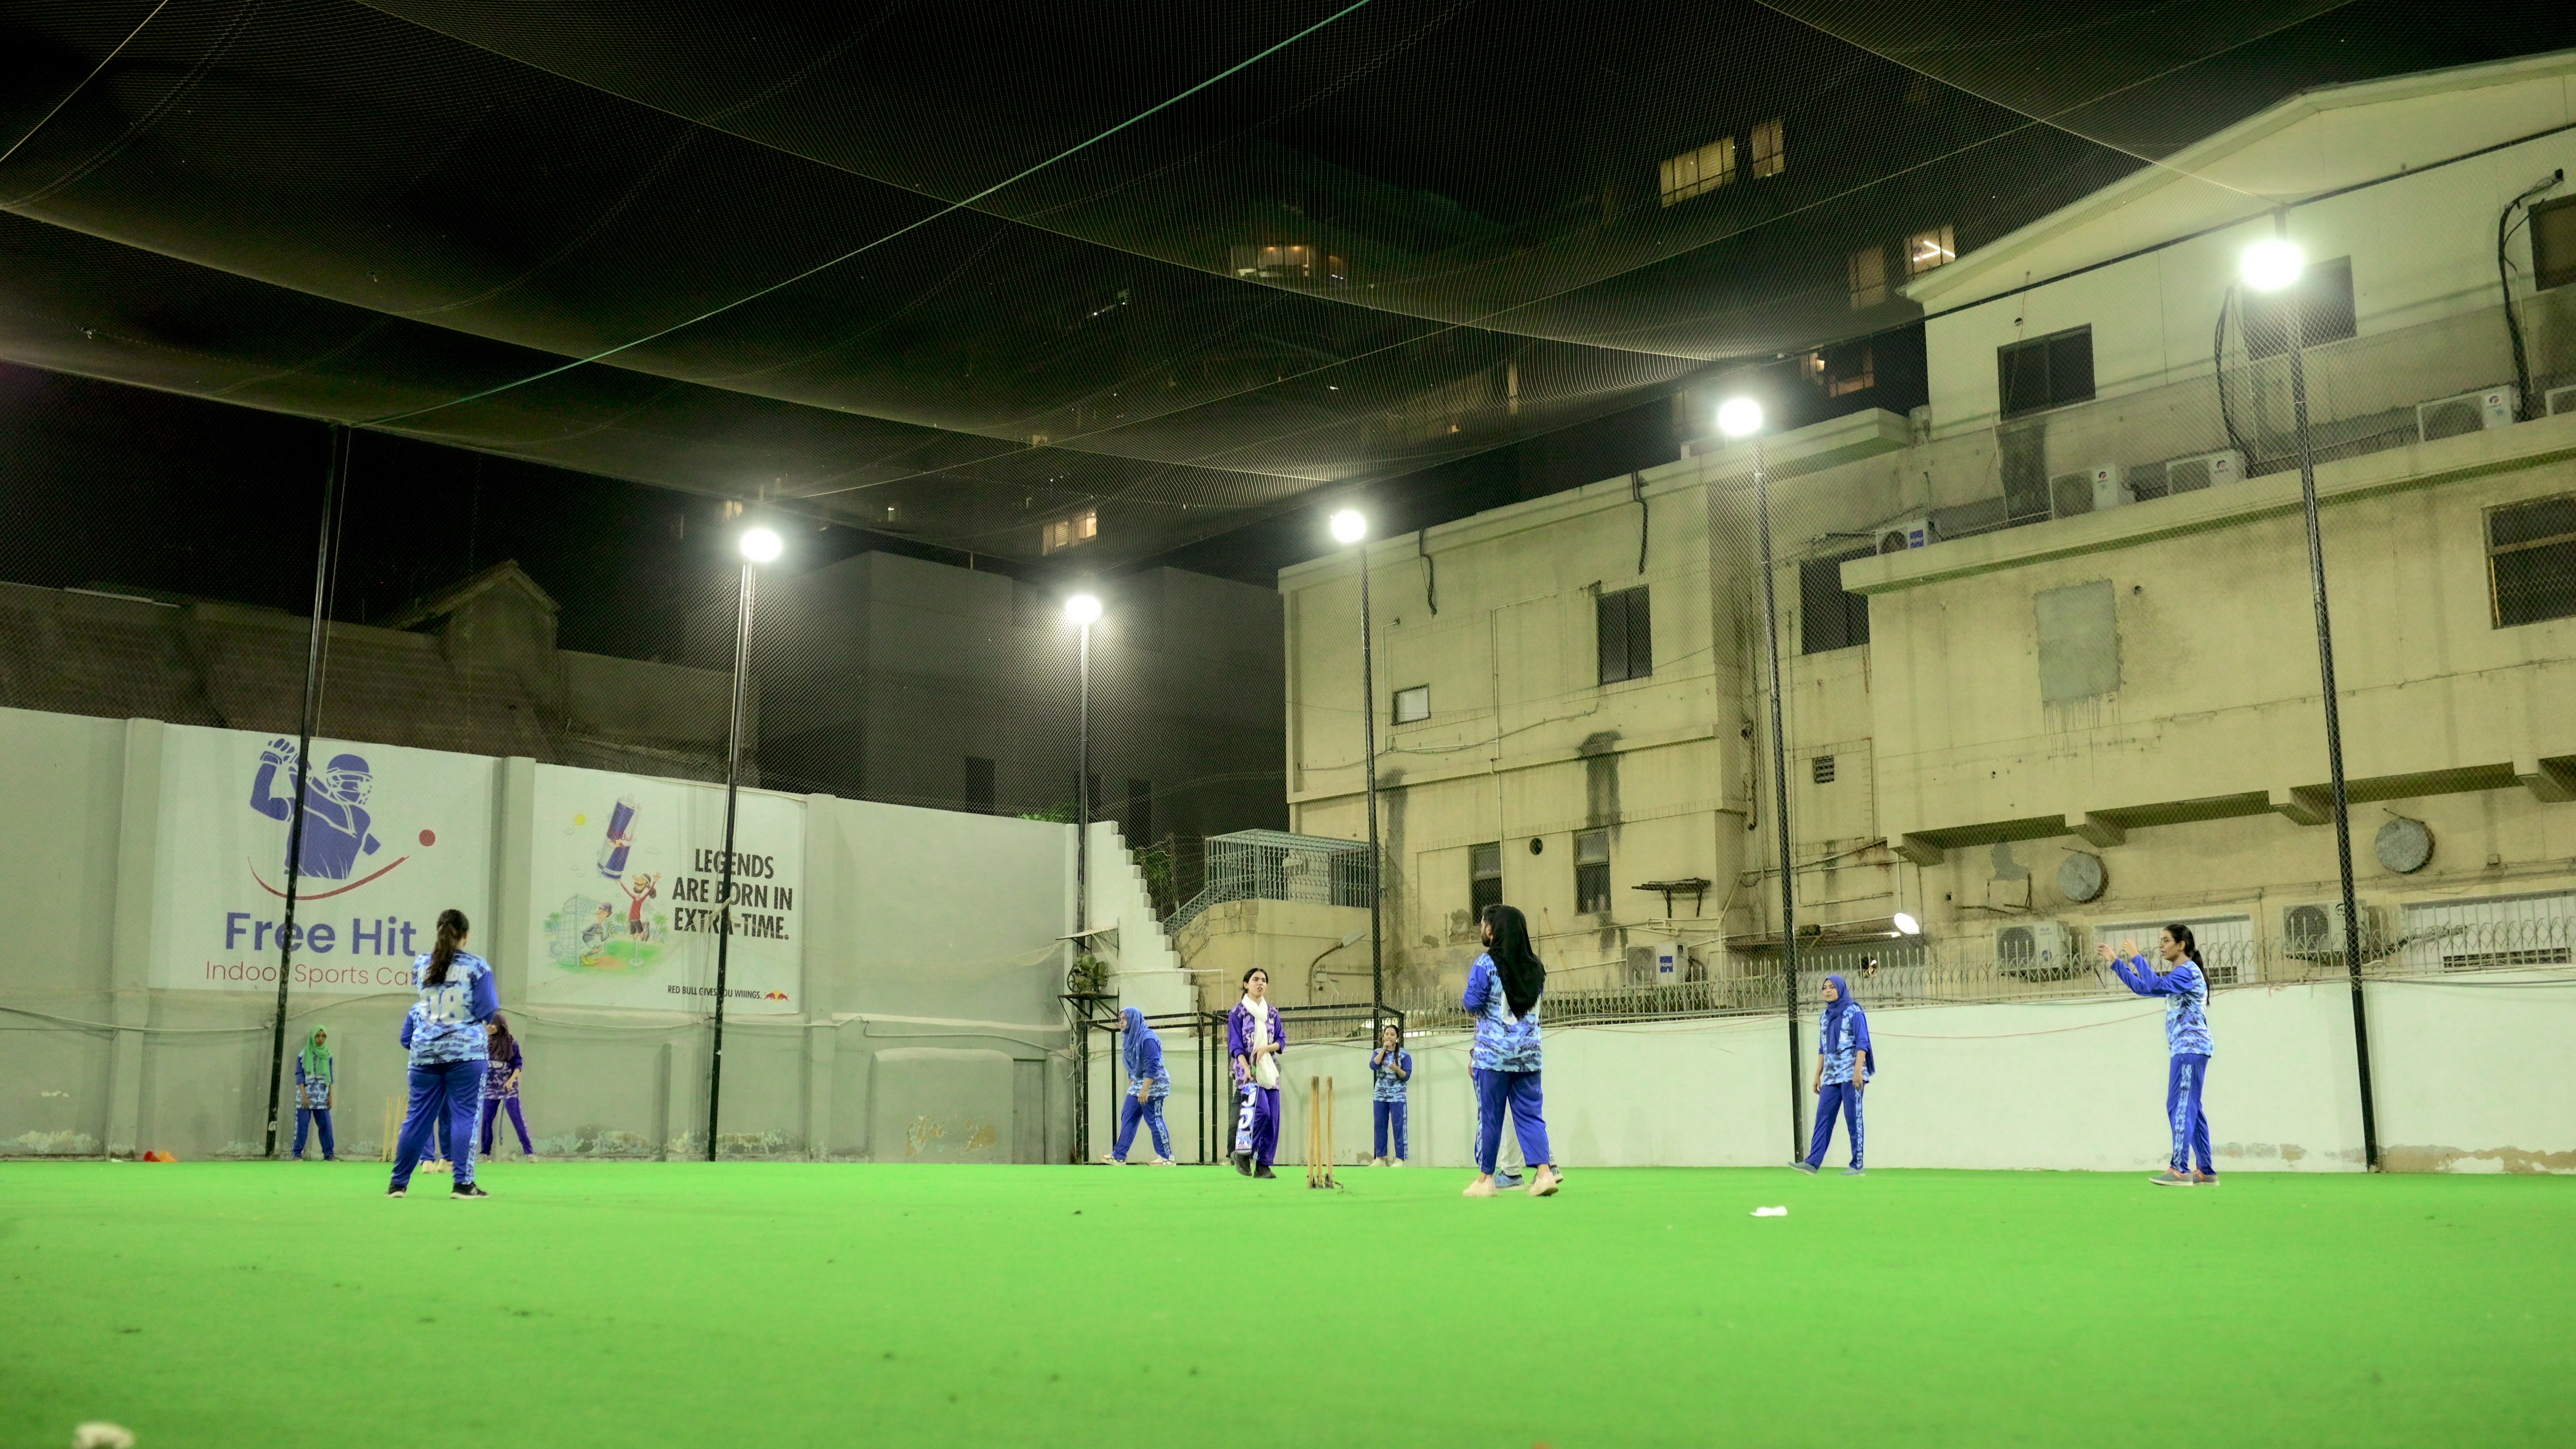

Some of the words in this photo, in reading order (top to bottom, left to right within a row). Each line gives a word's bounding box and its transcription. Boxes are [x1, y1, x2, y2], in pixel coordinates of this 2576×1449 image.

[672, 877, 709, 903] ARE
[715, 880, 768, 908] BORN
[774, 886, 793, 911] IN
[226, 912, 336, 953] Free
[352, 916, 416, 957] Hit
[206, 961, 277, 981] Indoo
[295, 964, 369, 988] Sports
[668, 985, 680, 993] RED
[682, 986, 697, 995] BULL
[699, 987, 717, 996] GIVES
[735, 990, 762, 999] WIIINGS.
